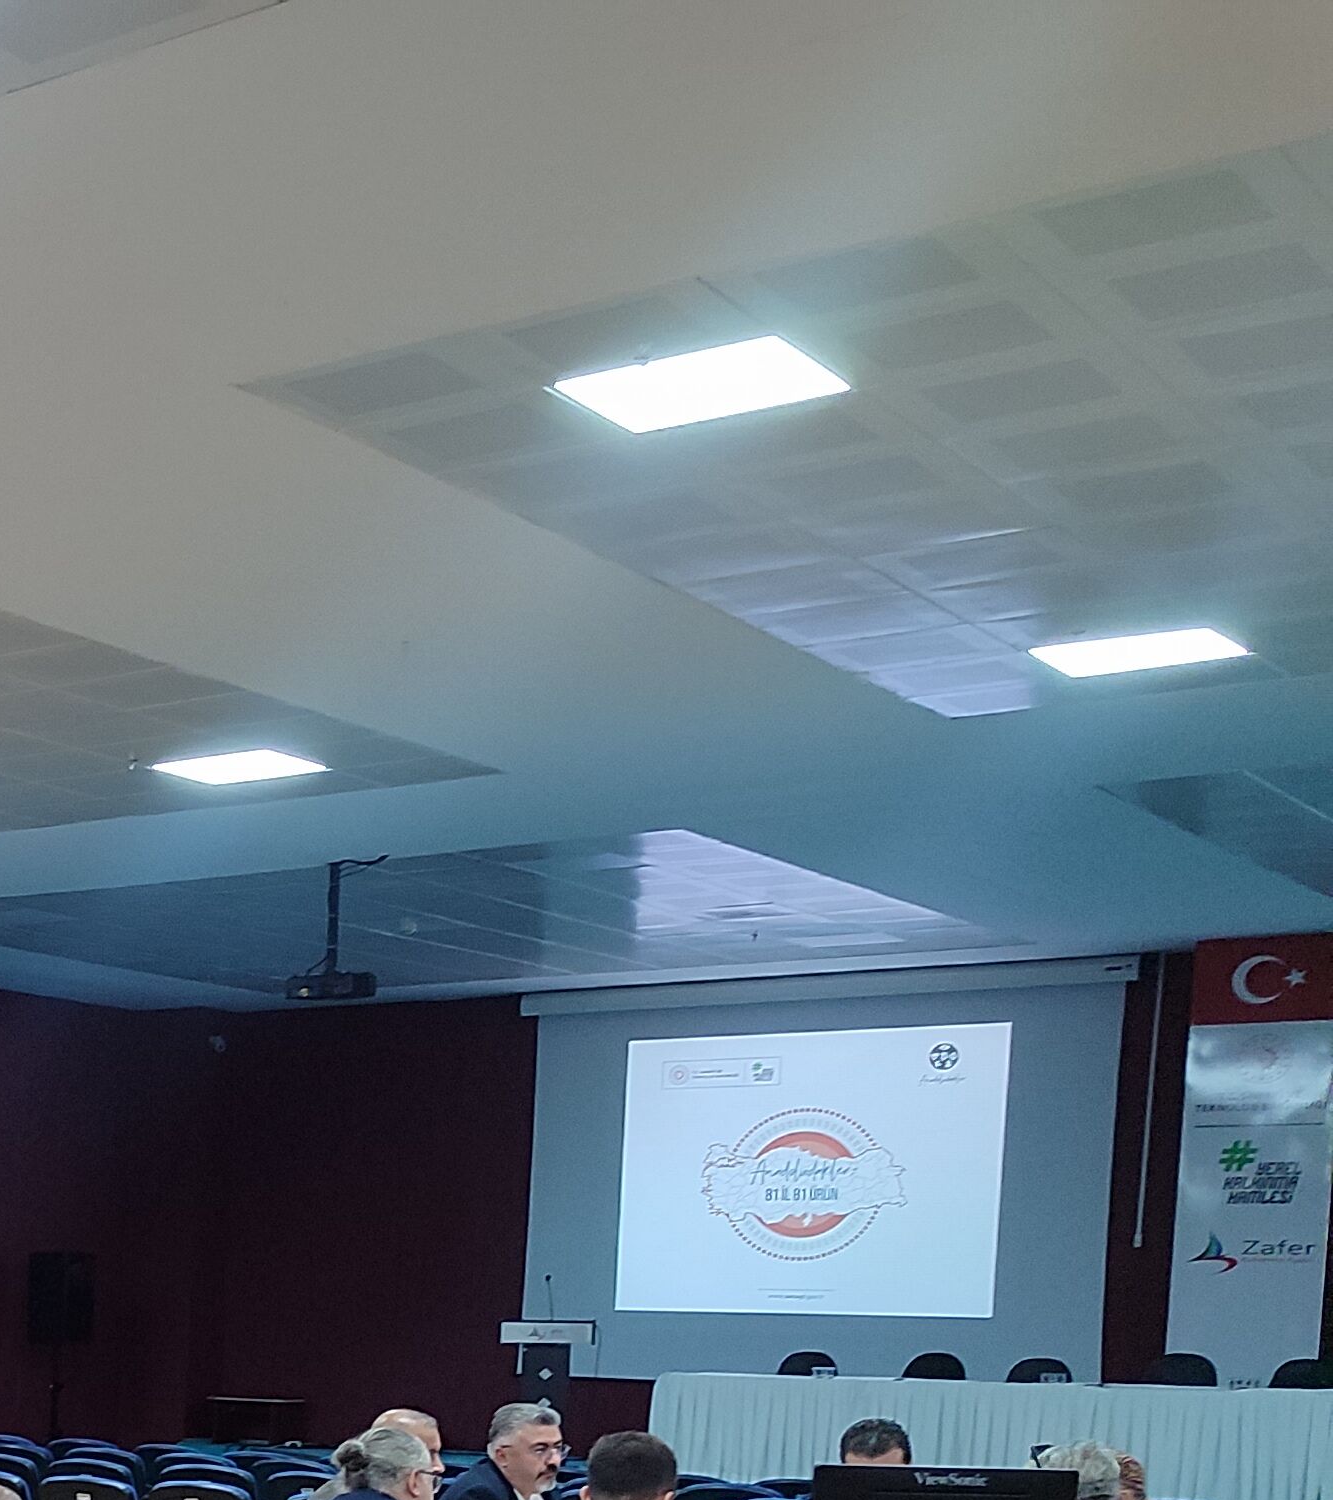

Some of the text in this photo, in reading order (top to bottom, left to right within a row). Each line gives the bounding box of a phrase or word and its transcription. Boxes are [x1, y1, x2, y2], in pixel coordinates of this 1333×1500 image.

[765, 1187, 779, 1201] 81
[793, 1187, 806, 1201] 81
[1241, 1239, 1316, 1256] Zafer
[913, 1471, 990, 1487] ViewSonic
